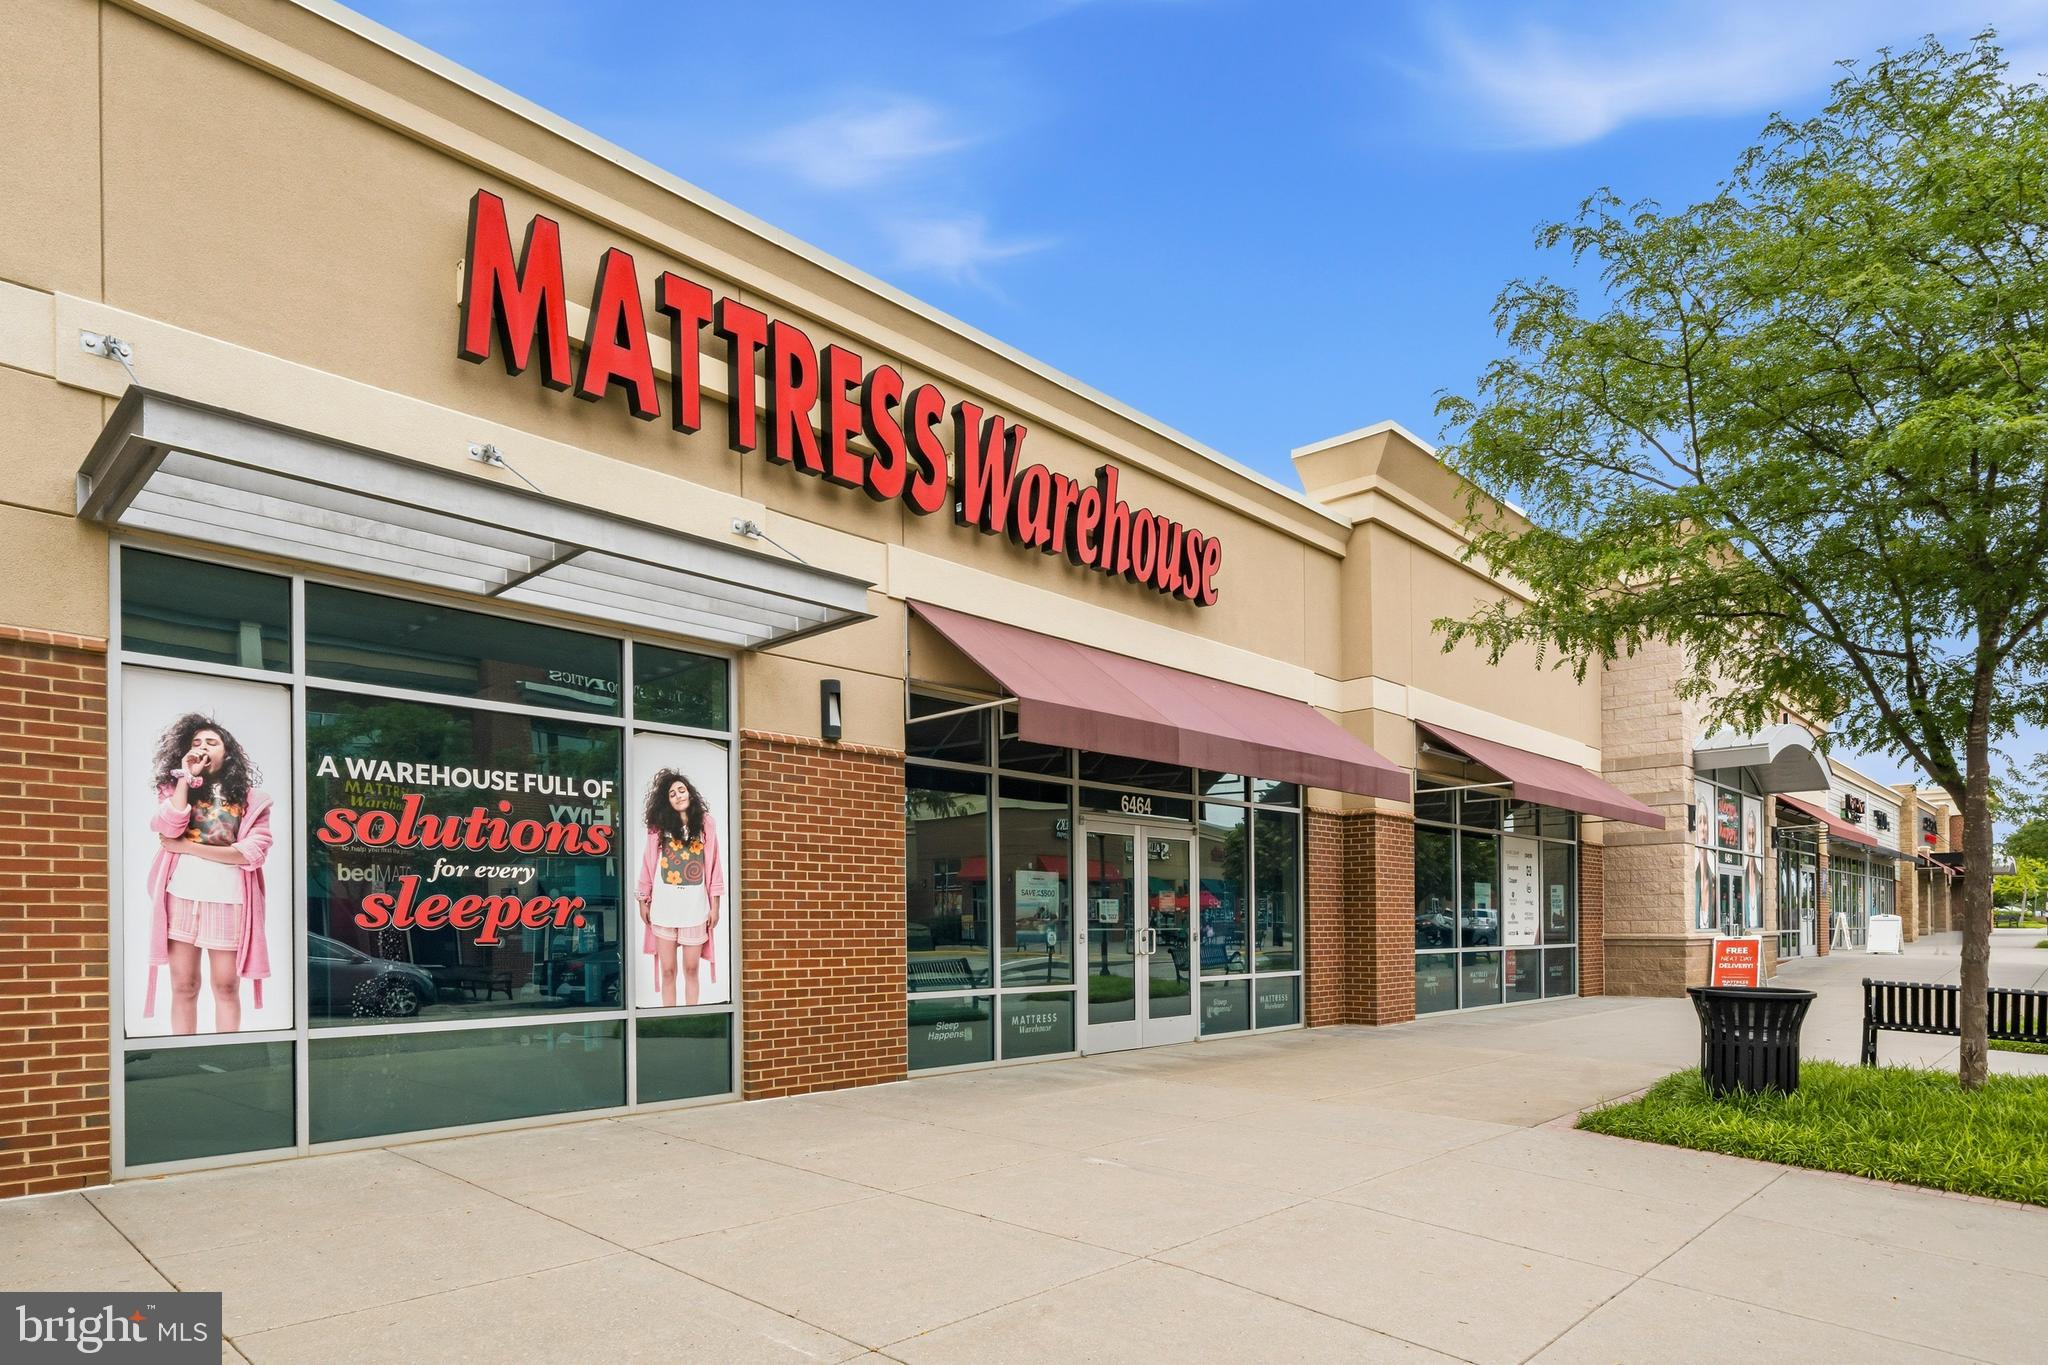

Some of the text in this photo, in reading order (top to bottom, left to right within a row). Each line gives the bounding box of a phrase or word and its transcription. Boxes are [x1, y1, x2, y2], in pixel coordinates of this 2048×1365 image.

[458, 189, 1221, 607] MATTRESS Warehouse
[316, 755, 614, 799] A WAREHOUSE FULL OF
[1121, 795, 1152, 815] 6464
[316, 793, 615, 856] solutions
[427, 857, 536, 884] for every
[355, 874, 587, 946] sleeper.
[1726, 946, 1749, 955] FREE
[935, 1021, 960, 1032] Sleep
[1011, 1013, 1057, 1025] MATTRESS
